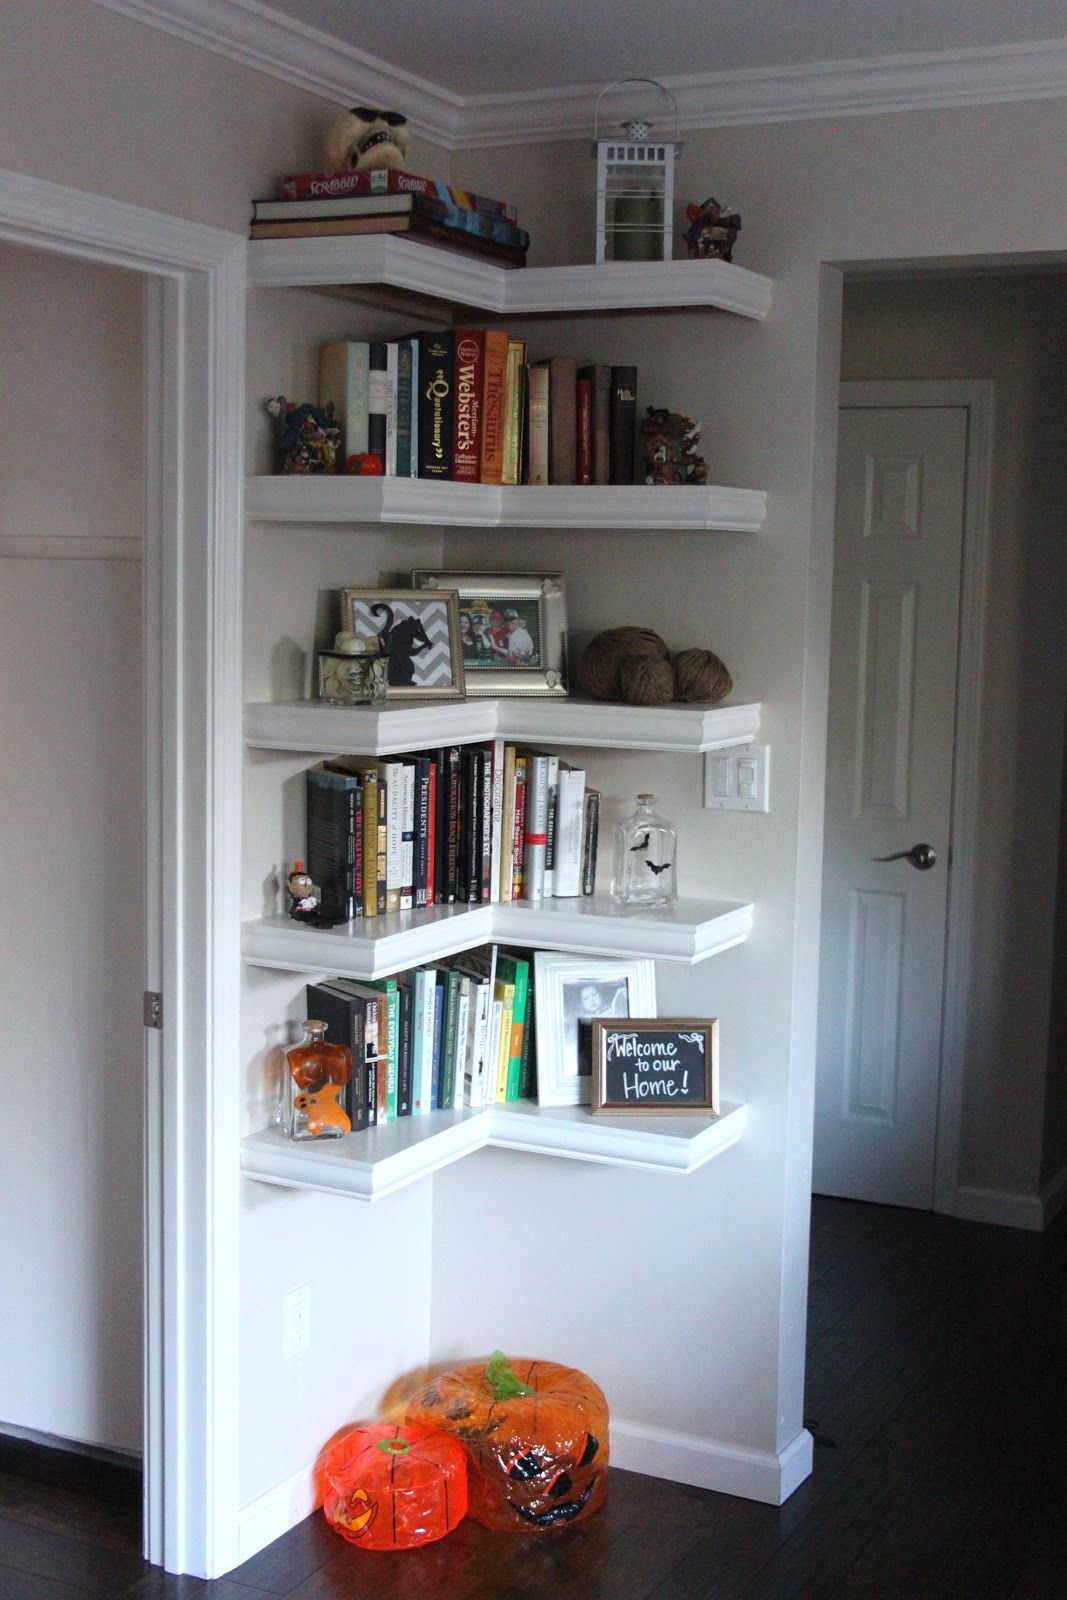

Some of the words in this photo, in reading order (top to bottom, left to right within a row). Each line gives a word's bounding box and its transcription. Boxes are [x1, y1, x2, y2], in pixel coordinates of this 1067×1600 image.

[457, 364, 476, 450] Webster's
[471, 400, 480, 438] Merriam-
[485, 368, 504, 461] Thesaurus
[483, 761, 491, 776] THE
[420, 777, 429, 839] PRESIDENTS
[449, 773, 458, 821] OPERATION
[482, 777, 491, 842] PHOTOGRAPHER'S
[493, 769, 503, 823] Decorating
[447, 820, 457, 844] IRAQI
[482, 843, 490, 857] EYE
[448, 844, 456, 882] FREEDOM
[387, 1003, 395, 1019] THE
[387, 1020, 395, 1061] EVERYDAY
[479, 1024, 488, 1050] ROME
[614, 1035, 678, 1058] Welcome
[387, 1063, 395, 1094] GENIUS
[635, 1058, 650, 1072] to
[652, 1059, 681, 1072] our
